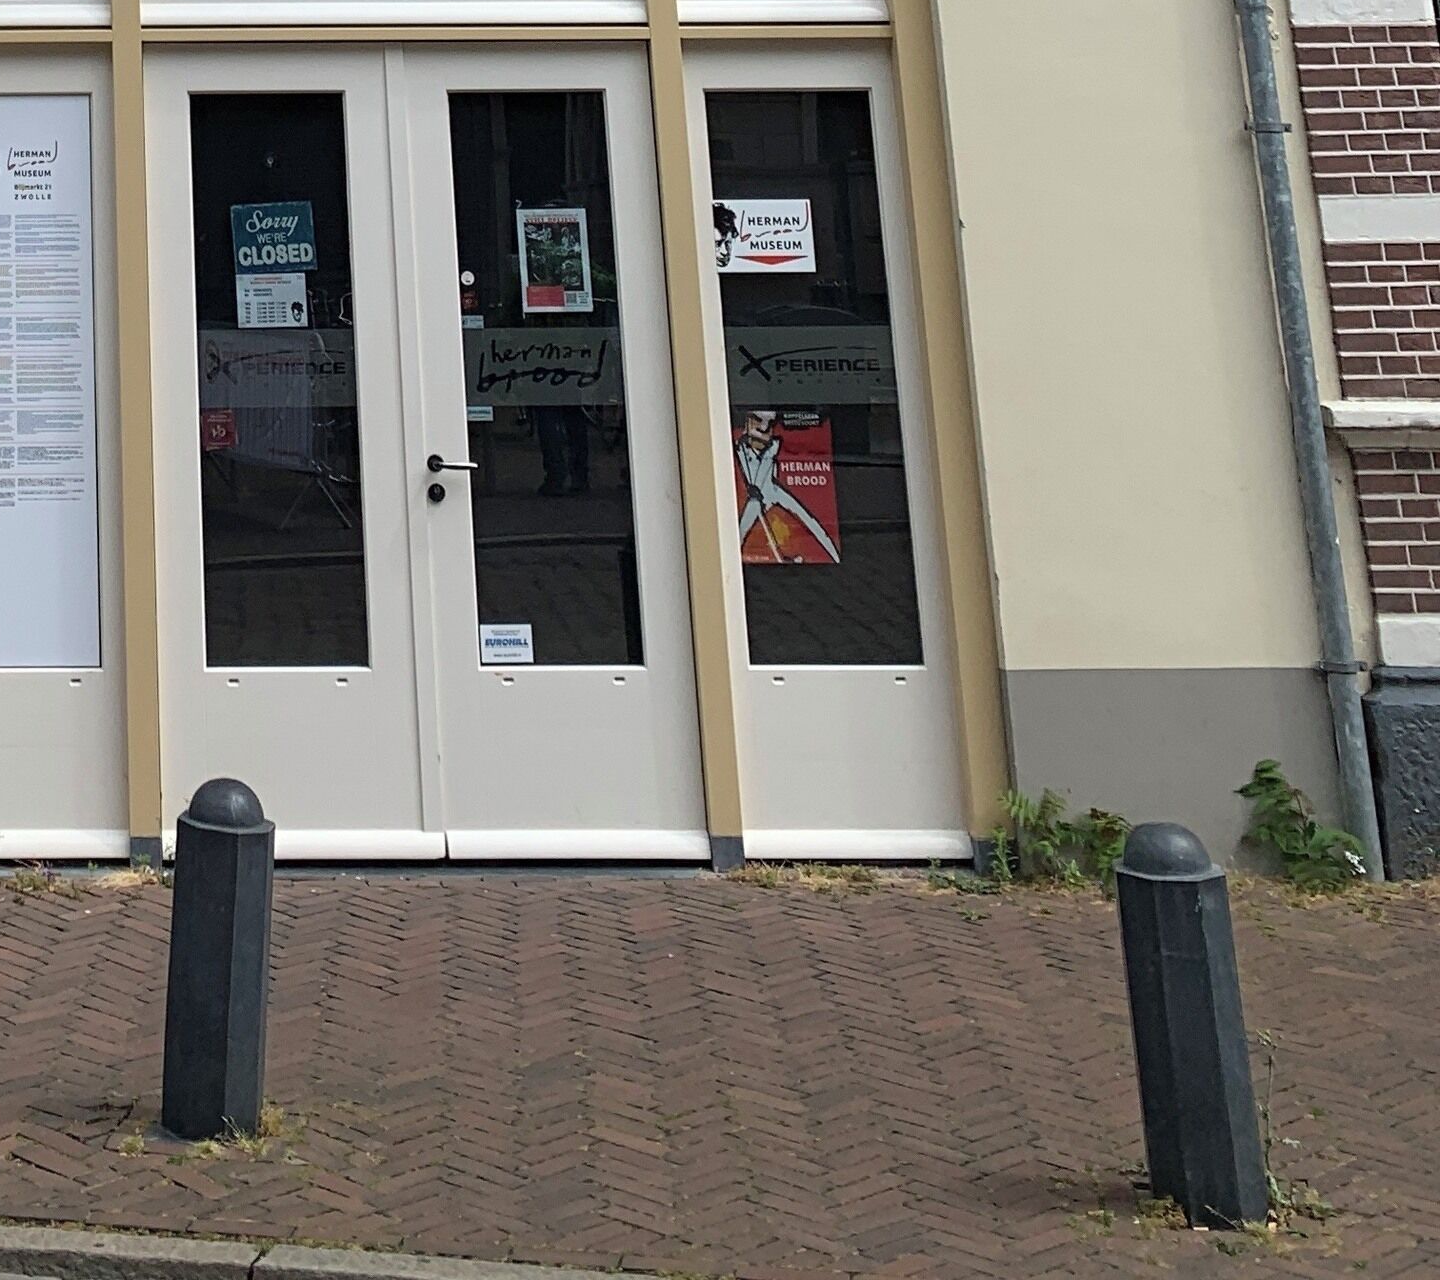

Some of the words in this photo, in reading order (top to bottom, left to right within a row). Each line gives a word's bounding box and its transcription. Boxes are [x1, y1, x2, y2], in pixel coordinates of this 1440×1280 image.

[13, 150, 51, 158] HERMAN
[14, 169, 52, 177] MUSEUM
[246, 210, 299, 237] Sorry
[747, 216, 800, 226] HERMAN
[256, 232, 288, 244] WE'RE
[750, 240, 803, 250] MUSEUM
[238, 242, 313, 266] CLOSED
[491, 339, 592, 364] herman
[477, 339, 608, 392] brood
[781, 461, 831, 472] HERMAN
[787, 475, 827, 486] BROOD
